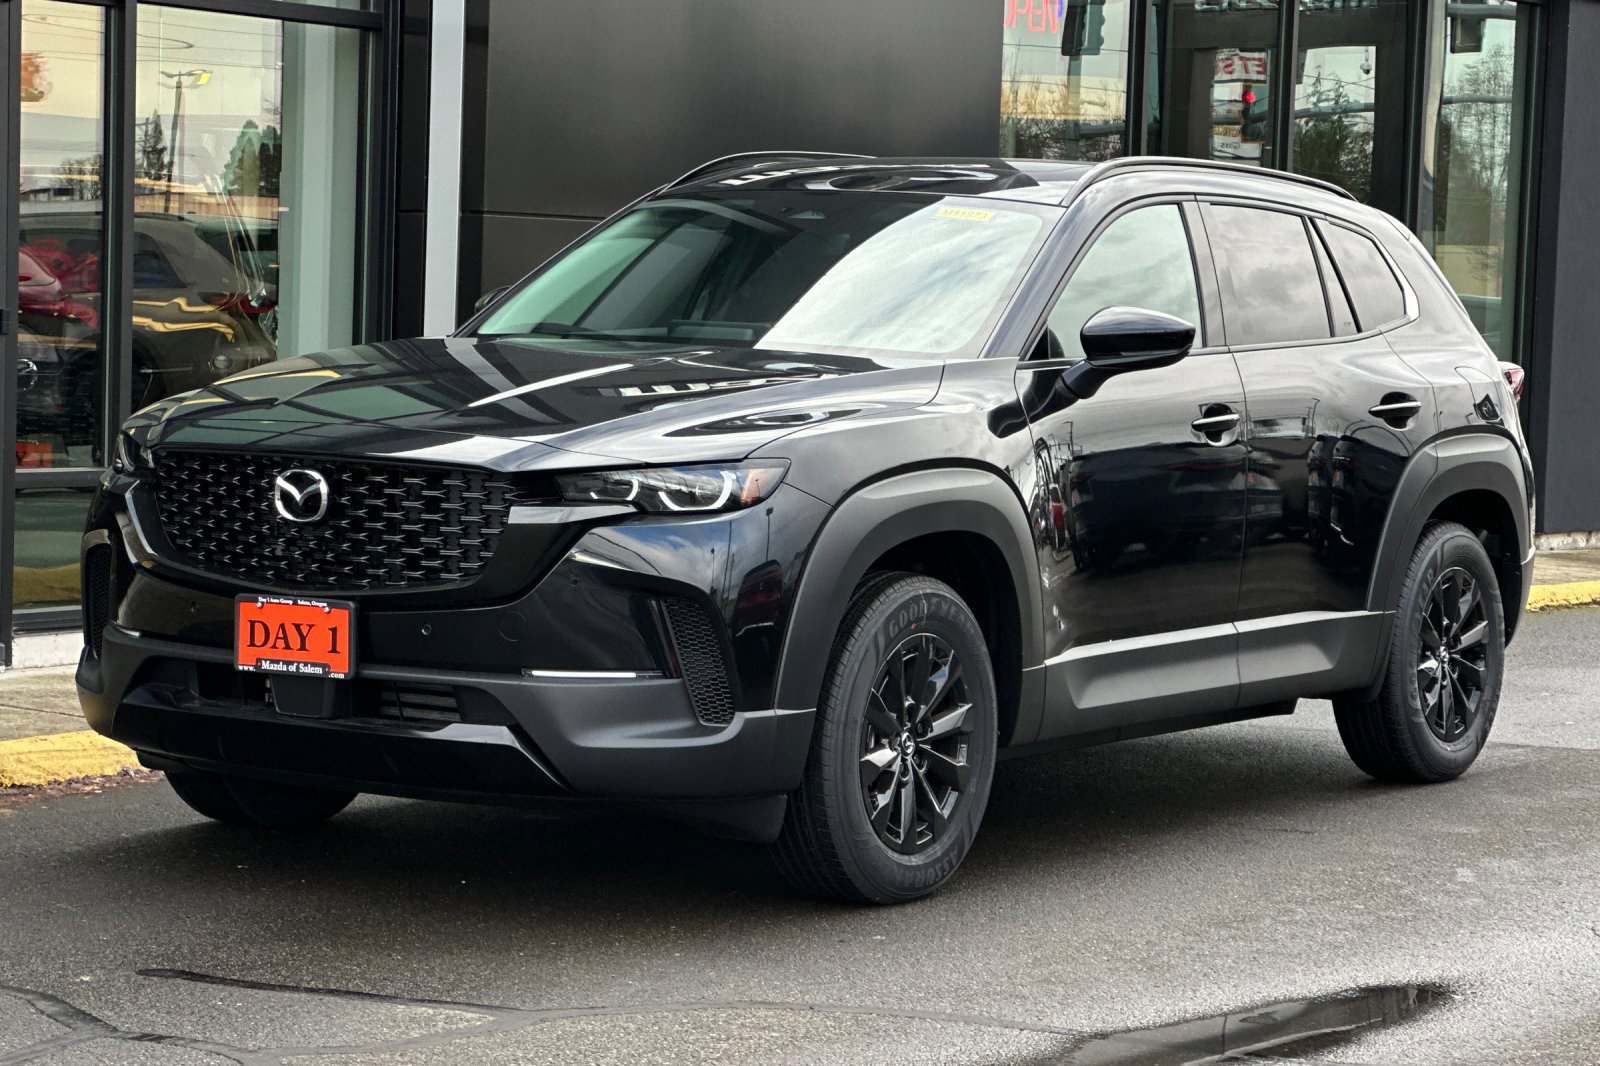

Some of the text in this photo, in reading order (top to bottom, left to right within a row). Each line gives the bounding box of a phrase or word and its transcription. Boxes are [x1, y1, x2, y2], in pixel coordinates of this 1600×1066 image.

[247, 619, 341, 655] DAY 1
[261, 660, 287, 672] Mazda
[288, 663, 298, 672] of
[299, 663, 323, 674] Salem
